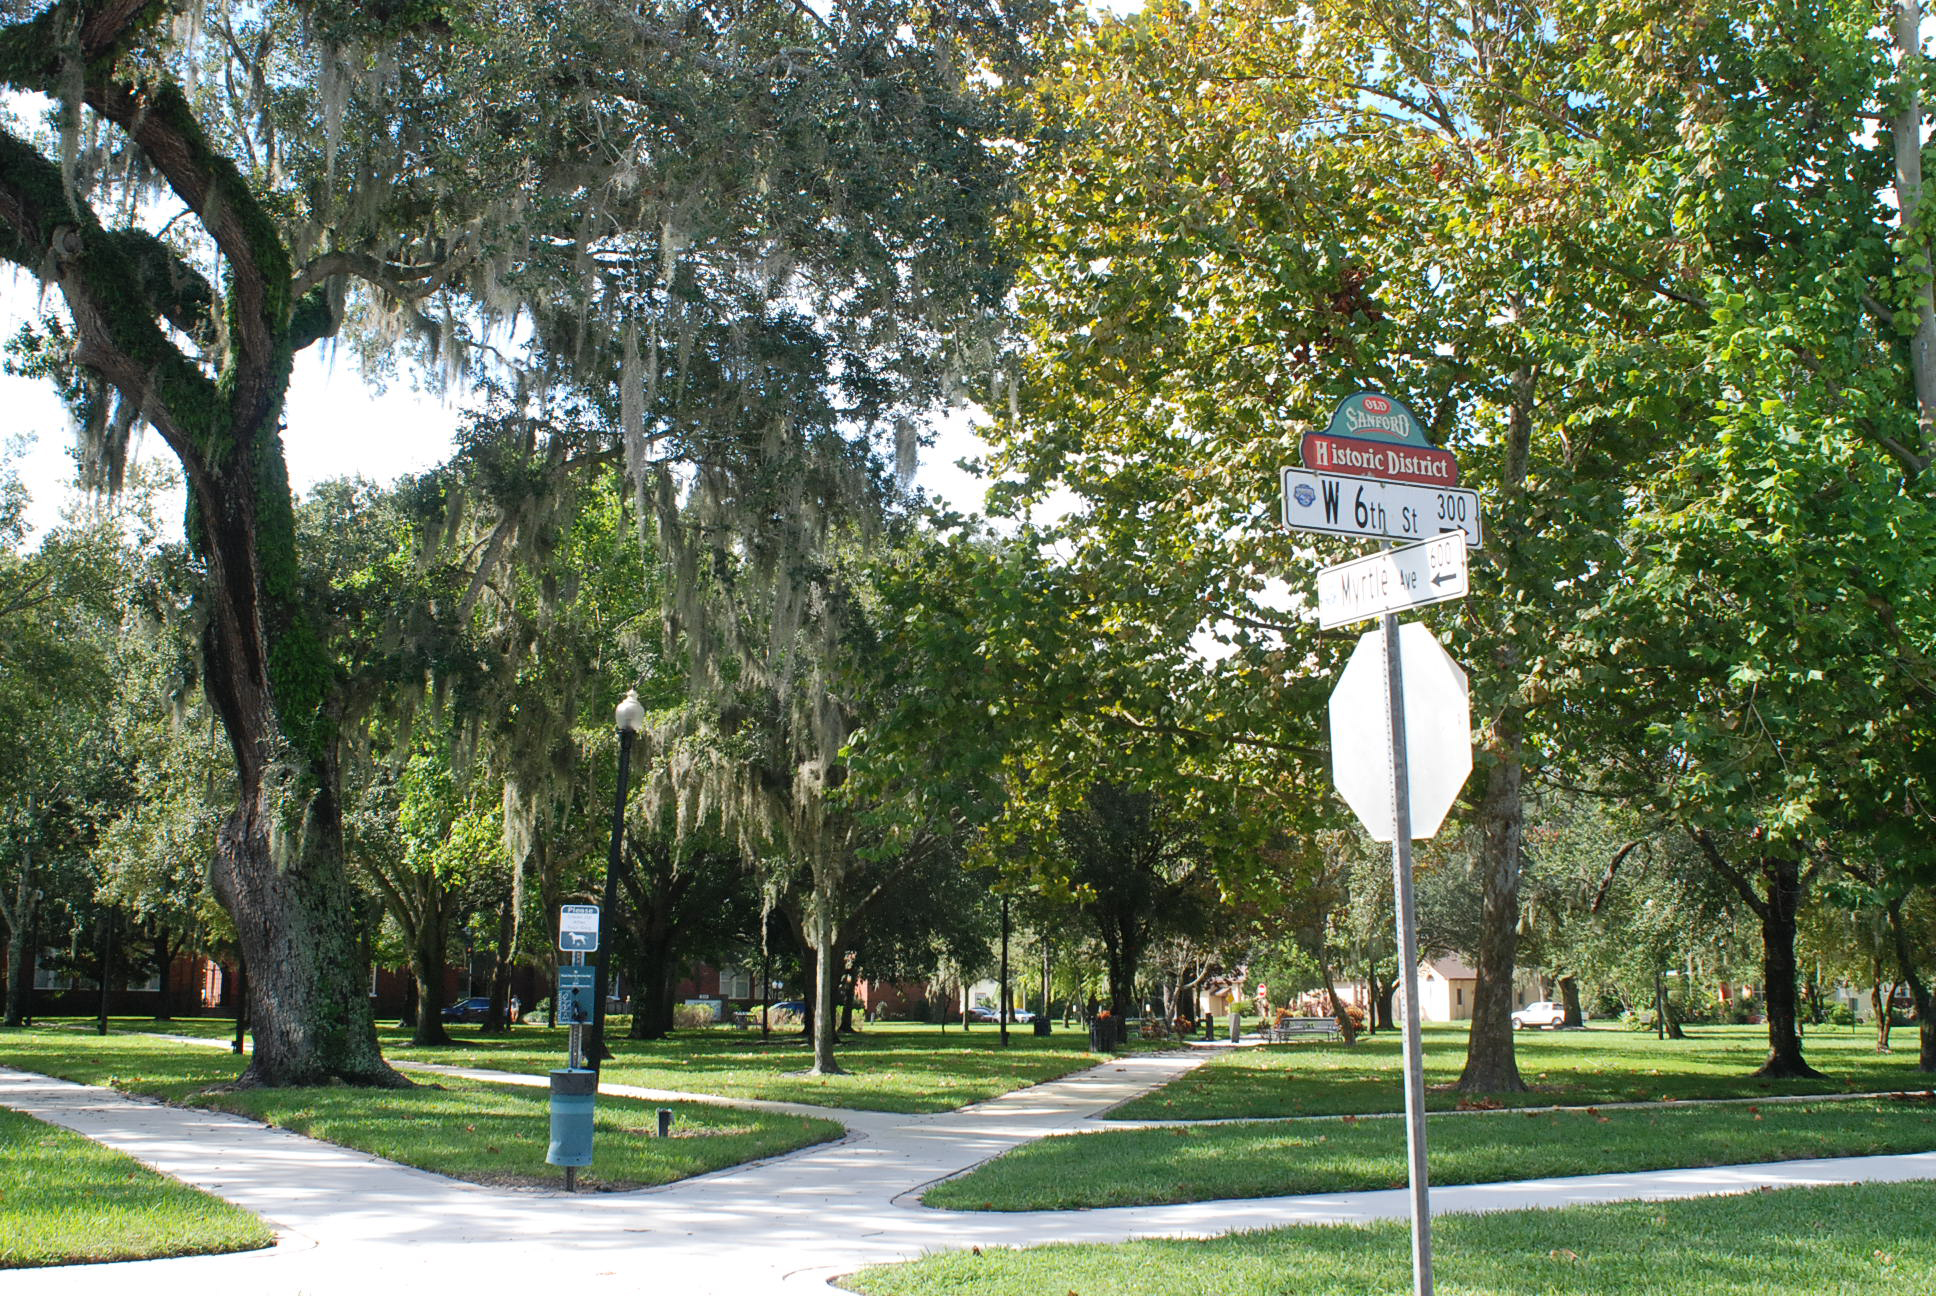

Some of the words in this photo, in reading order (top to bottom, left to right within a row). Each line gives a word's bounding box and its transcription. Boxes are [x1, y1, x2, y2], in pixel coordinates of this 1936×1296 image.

[1365, 399, 1387, 411] OLD
[1346, 406, 1410, 437] SANFORD
[1314, 440, 1385, 470] Historic
[1387, 450, 1448, 478] District
[1322, 480, 1339, 525] W
[1355, 485, 1387, 531] 6th
[1402, 506, 1418, 534] St
[1437, 493, 1466, 522] 300
[1430, 542, 1452, 569] 600
[1341, 565, 1388, 615] Myrtle
[1400, 568, 1417, 591] Ave
